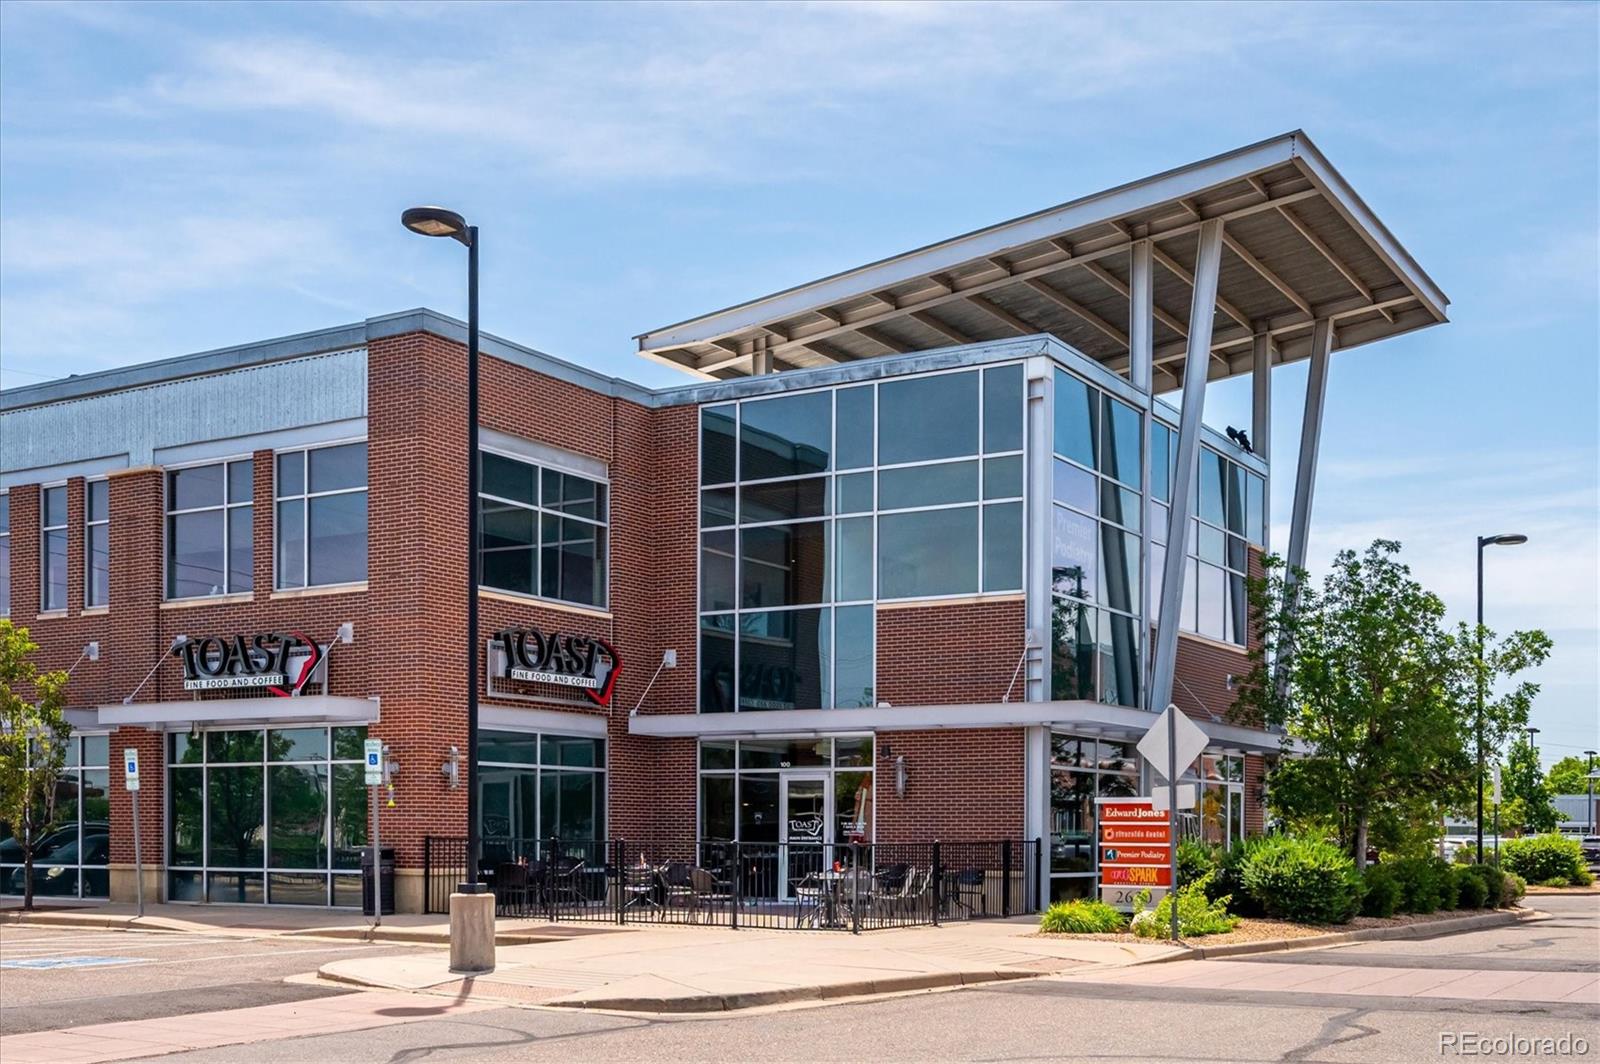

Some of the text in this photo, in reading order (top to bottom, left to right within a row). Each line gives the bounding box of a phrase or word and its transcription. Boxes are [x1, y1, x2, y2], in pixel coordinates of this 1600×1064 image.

[172, 631, 301, 679] TOAST
[494, 626, 609, 679] TOAST
[185, 676, 283, 688] FINE FOOD AND COFFEE
[512, 670, 596, 687] FINE FOOD AND COFFEE
[789, 819, 819, 831] TOAST
[1117, 850, 1166, 861] Premier Podiatry
[1115, 890, 1153, 904] 260
